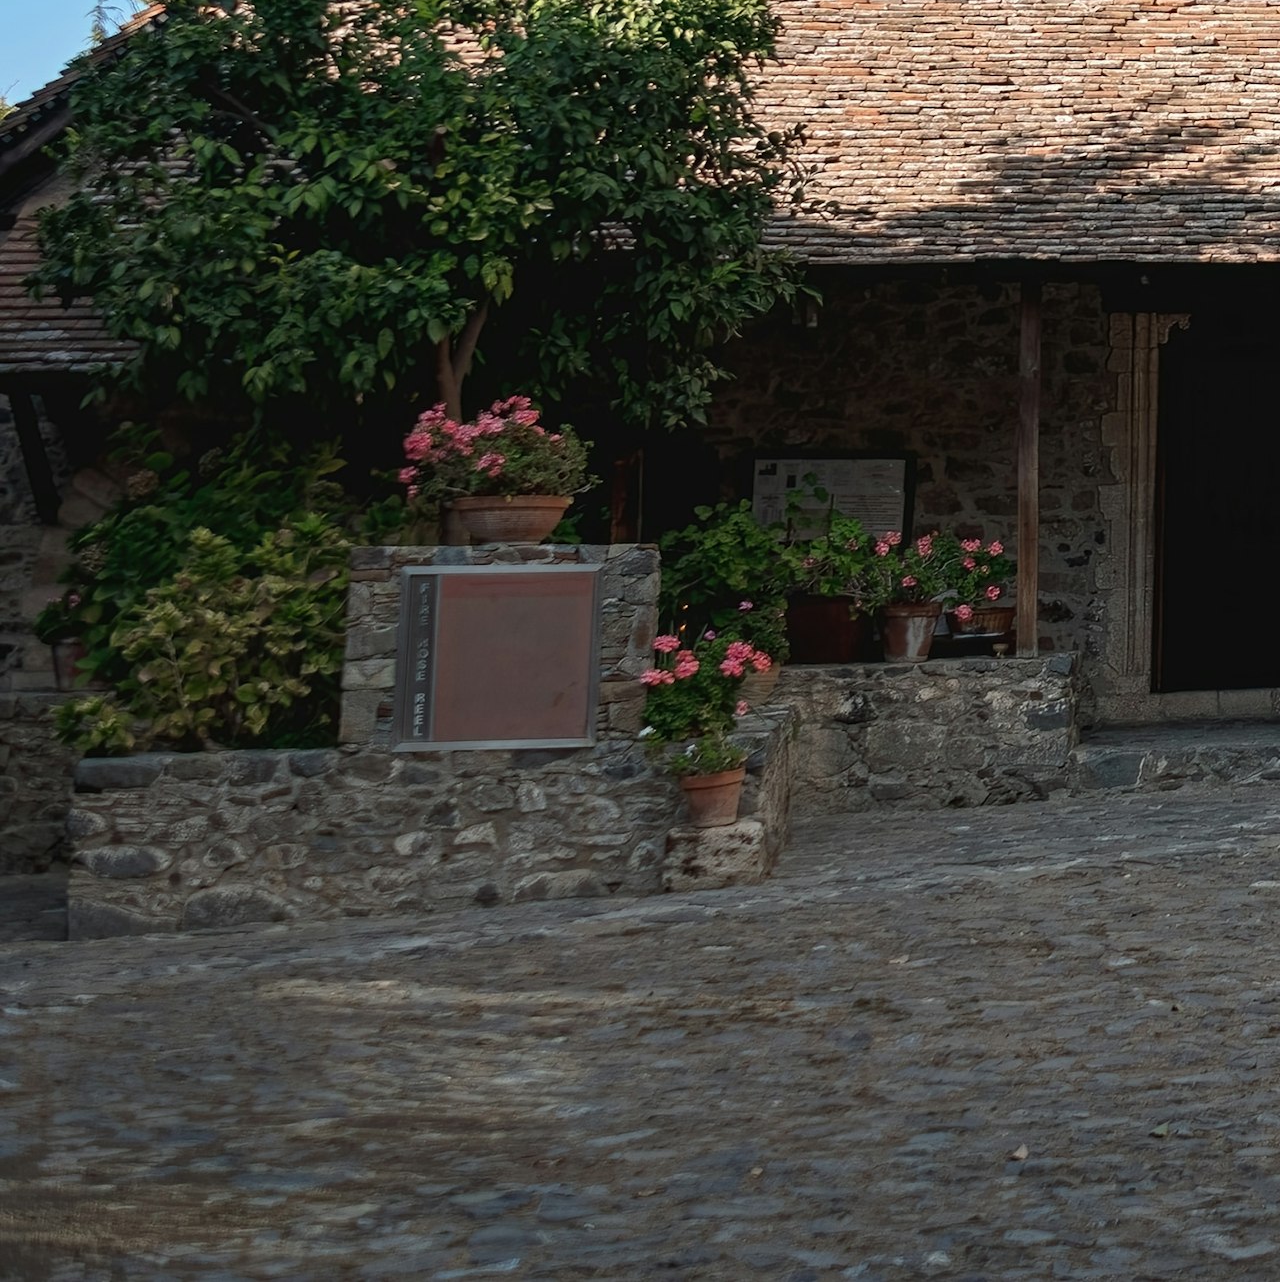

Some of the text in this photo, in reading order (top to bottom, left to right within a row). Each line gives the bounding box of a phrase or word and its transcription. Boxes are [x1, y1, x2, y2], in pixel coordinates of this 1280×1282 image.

[413, 582, 430, 736] FIRE HOSE REEL
